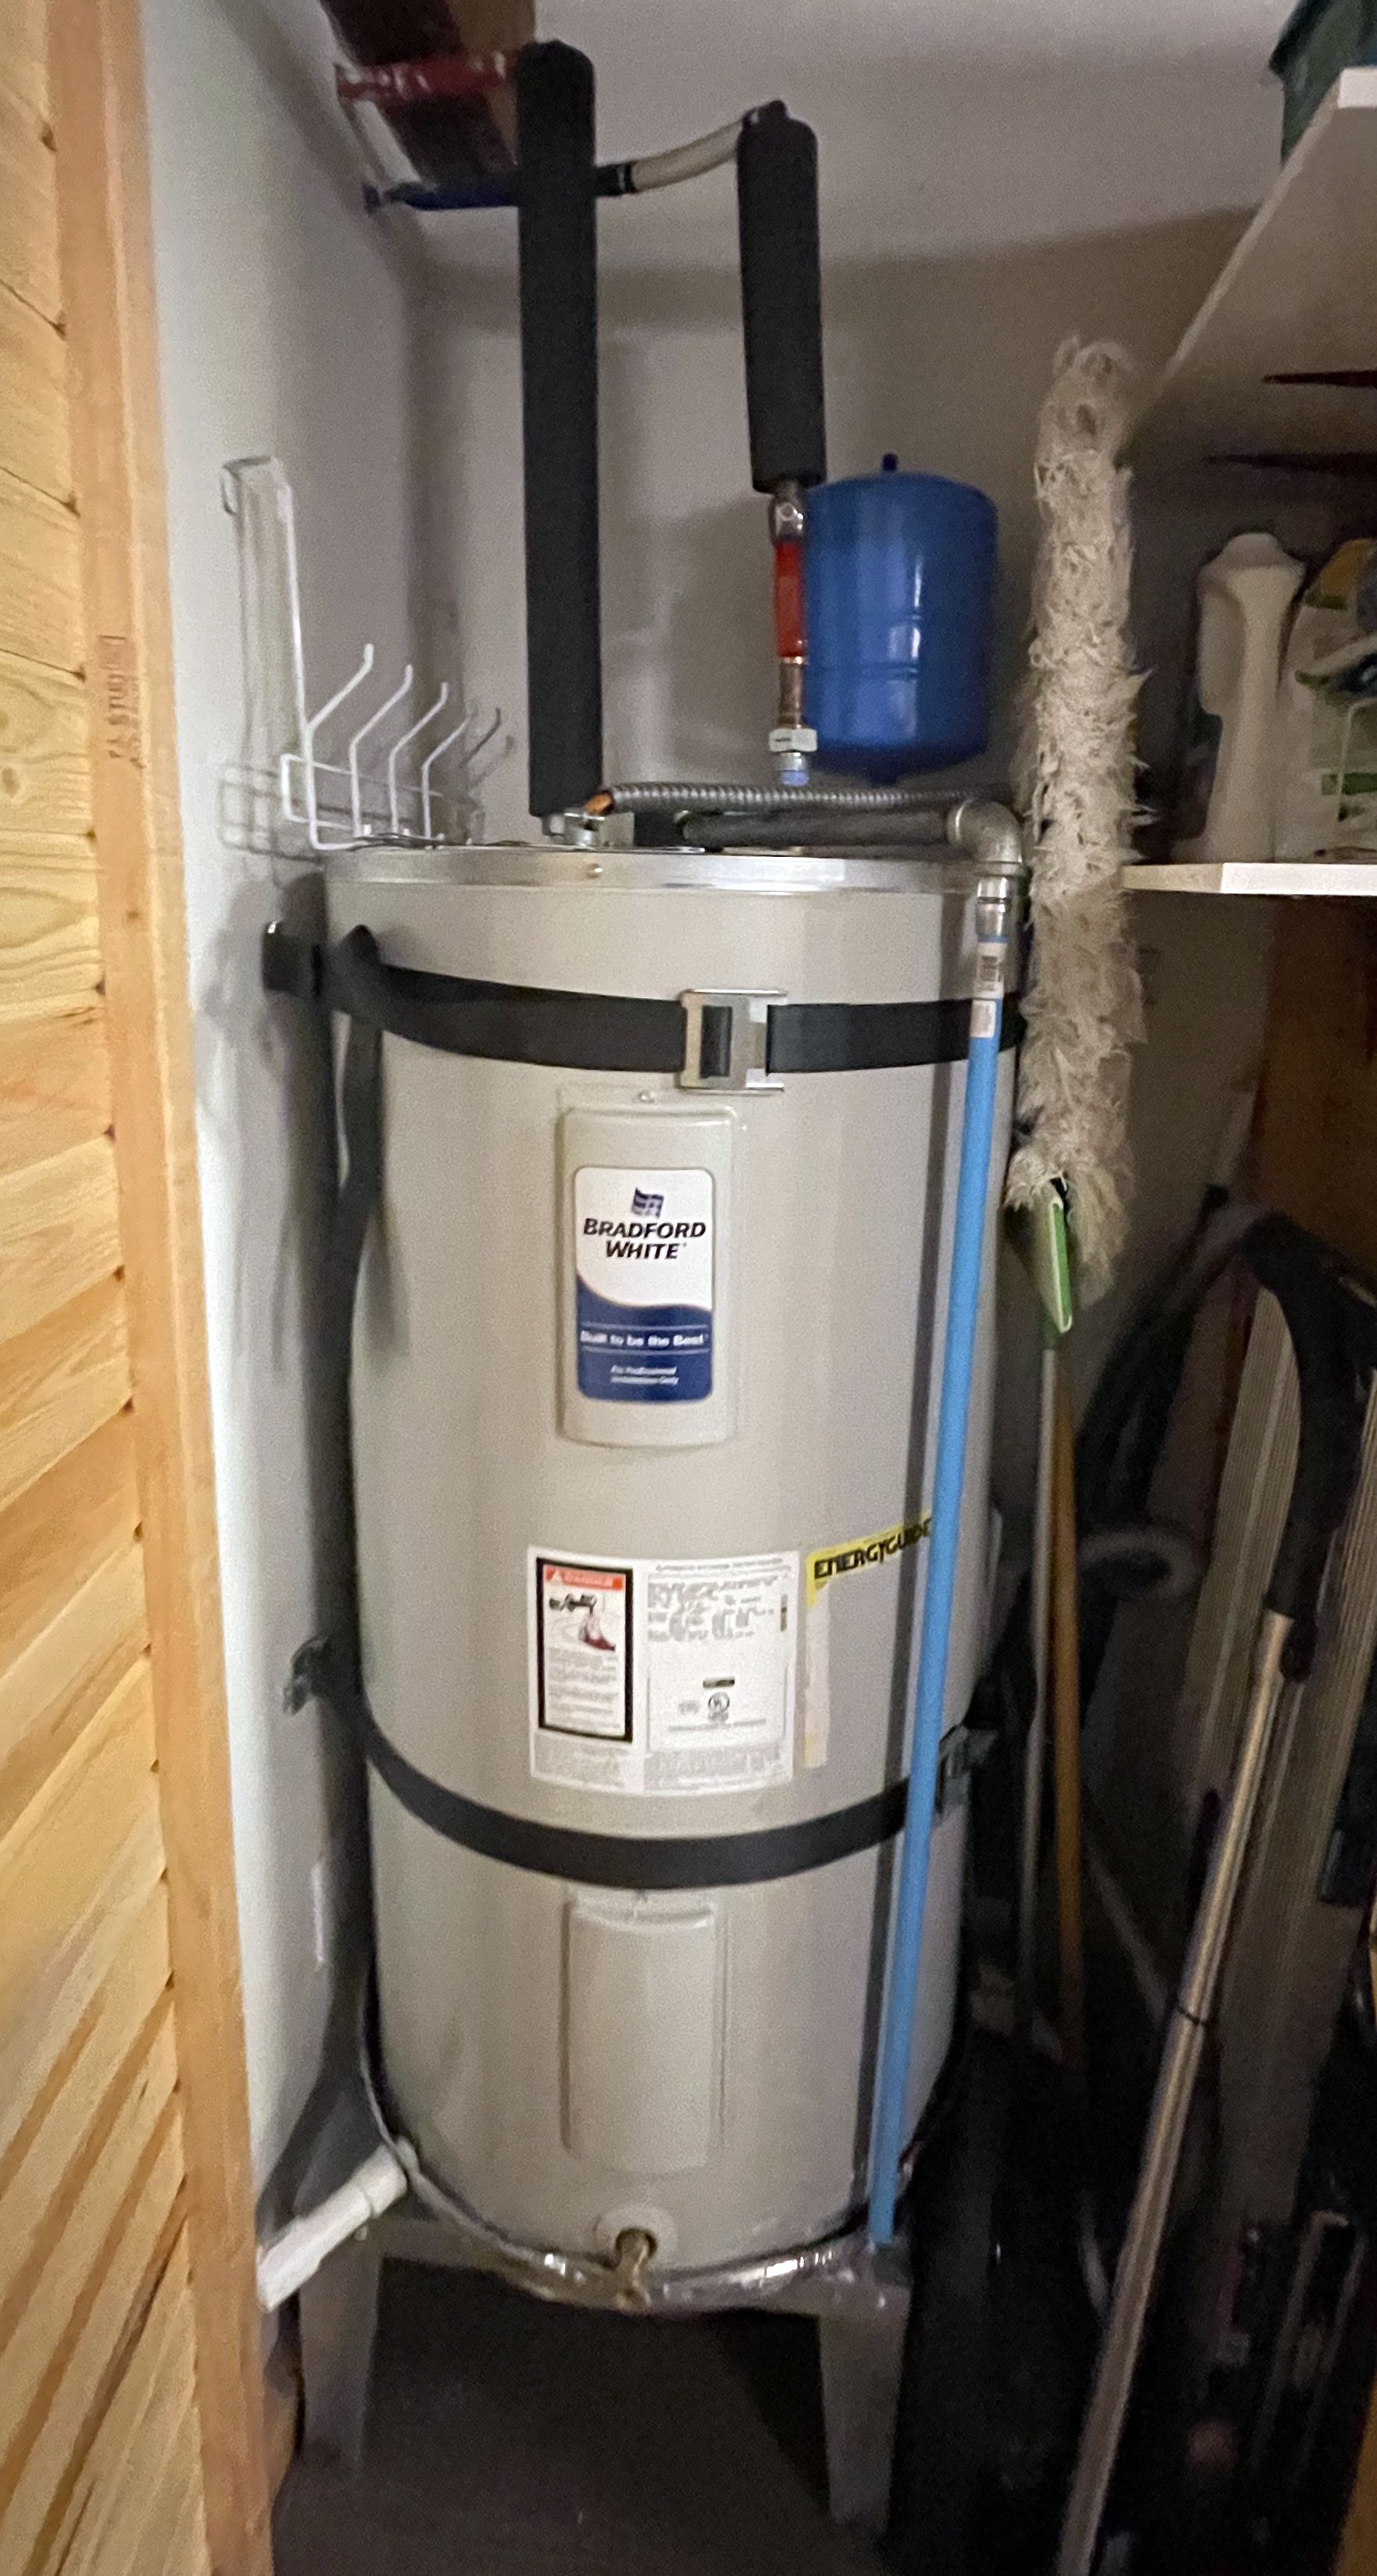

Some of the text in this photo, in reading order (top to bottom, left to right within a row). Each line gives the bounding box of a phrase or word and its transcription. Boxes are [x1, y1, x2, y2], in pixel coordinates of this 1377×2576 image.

[583, 1217, 706, 1239] BRADFORD
[606, 1239, 681, 1260] WHITE
[610, 1334, 624, 1346] to
[627, 1334, 645, 1347] be
[647, 1334, 671, 1348] the
[673, 1334, 704, 1347] Best
